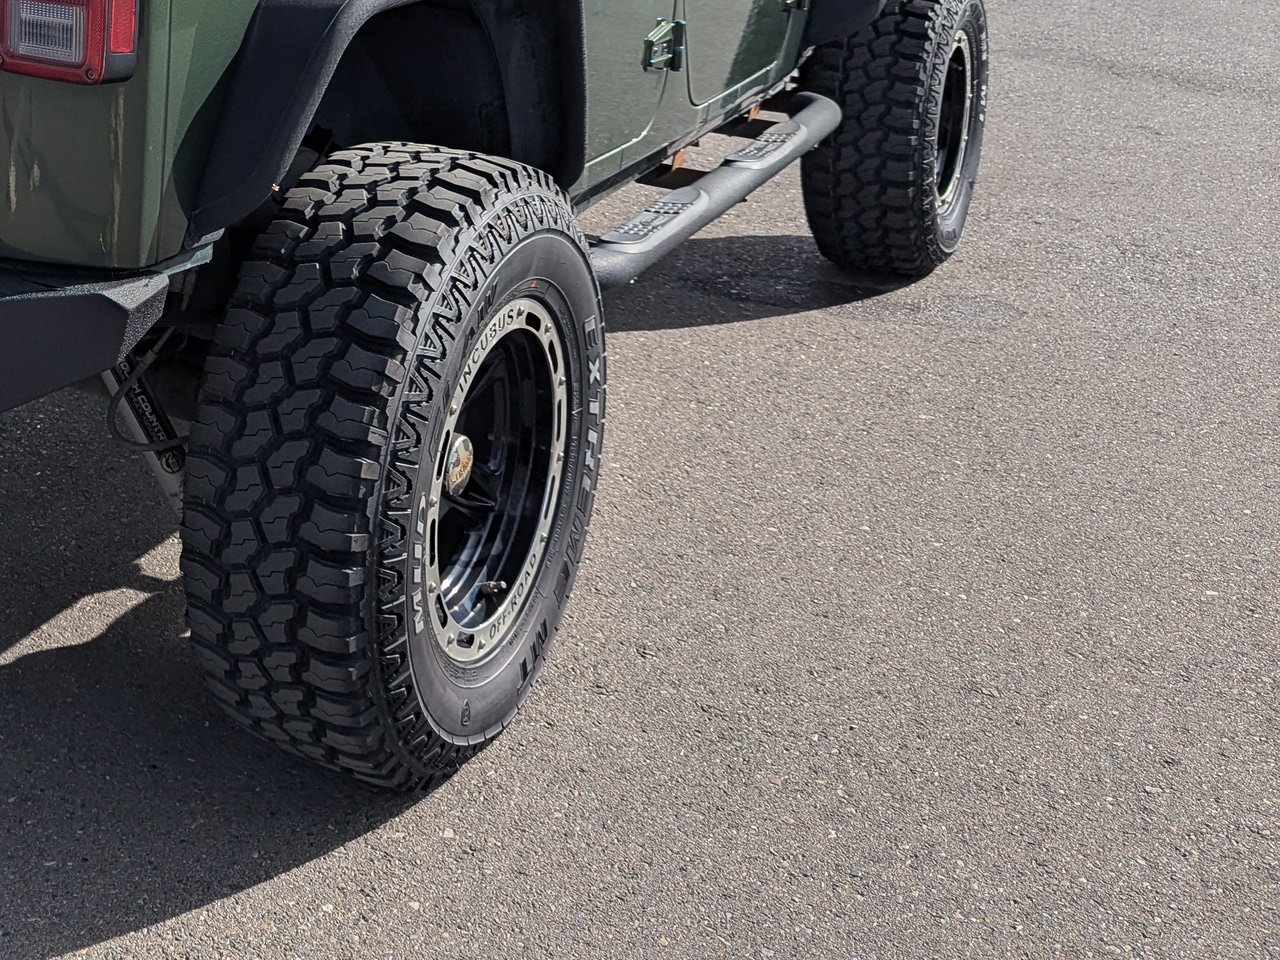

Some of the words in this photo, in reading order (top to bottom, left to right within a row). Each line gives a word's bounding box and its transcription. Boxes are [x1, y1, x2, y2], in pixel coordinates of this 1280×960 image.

[458, 308, 514, 393] INCUBUS
[411, 492, 427, 635] MUD
[489, 552, 537, 640] OFF-ROAD
